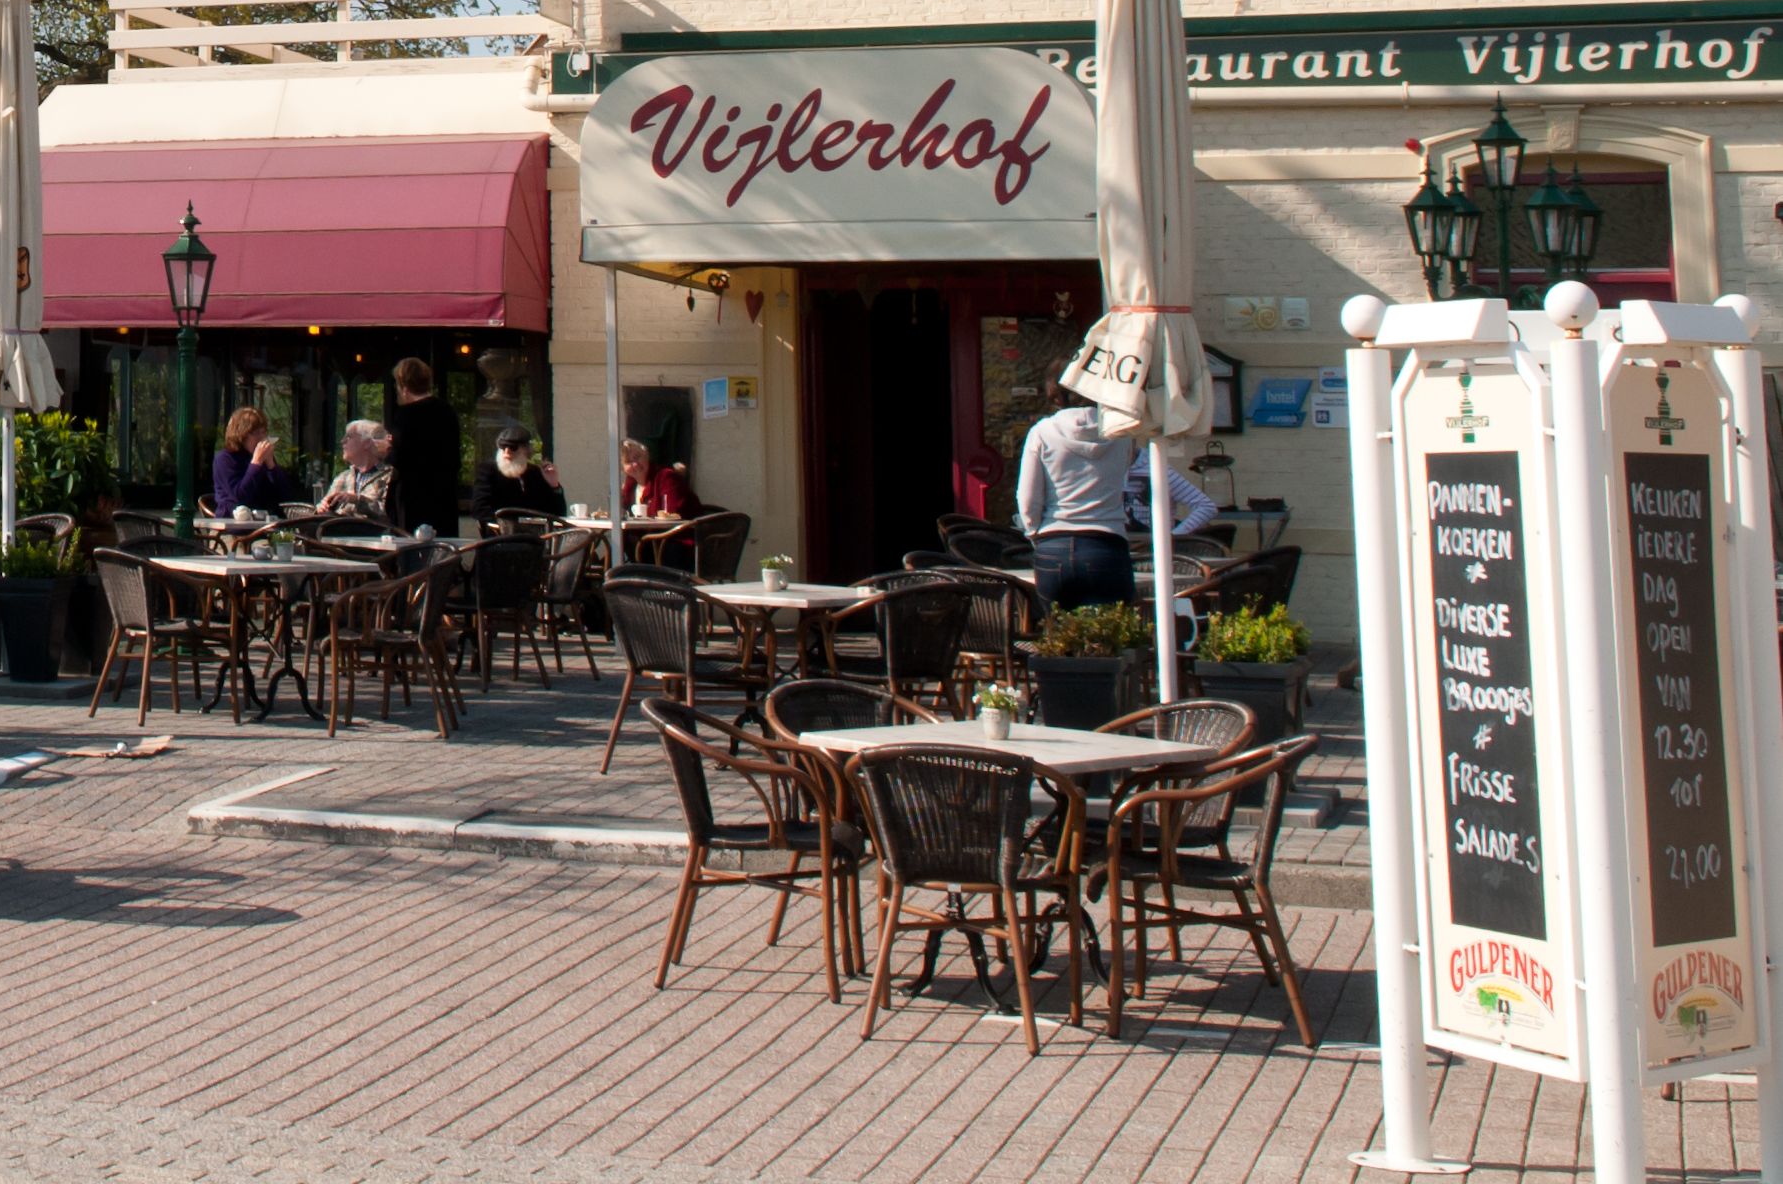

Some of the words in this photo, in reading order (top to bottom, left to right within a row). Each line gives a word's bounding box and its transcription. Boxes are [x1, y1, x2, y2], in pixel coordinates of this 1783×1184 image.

[1036, 41, 1401, 84] Reaurant
[1457, 27, 1773, 83] Vijlerhof
[631, 78, 1051, 207] Vijlerhof
[1631, 482, 1701, 519] KEUKEN
[1437, 525, 1513, 561] KOEKEN
[1442, 635, 1491, 677] LUXE
[1656, 674, 1691, 711] VAN
[1655, 723, 1708, 760] 12.30
[1665, 843, 1721, 889] 21.00
[1450, 940, 1555, 1012] GULPENER
[1653, 950, 1744, 1020] GULPENER
